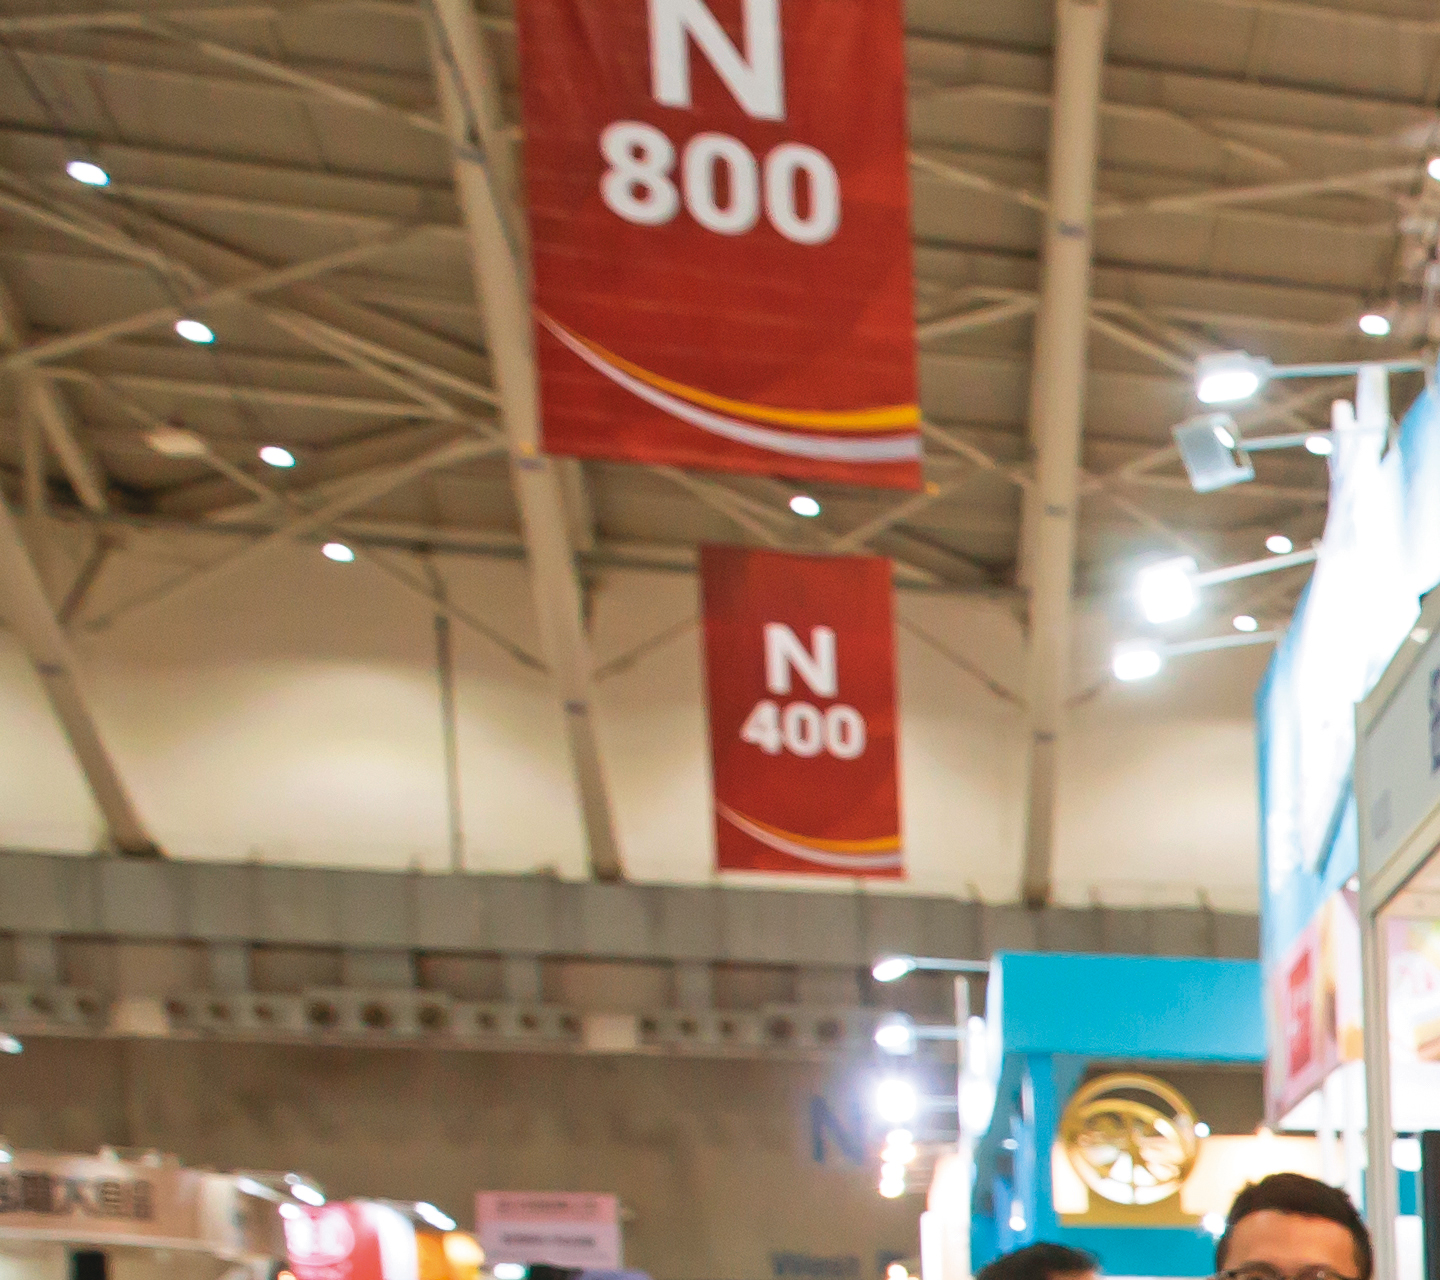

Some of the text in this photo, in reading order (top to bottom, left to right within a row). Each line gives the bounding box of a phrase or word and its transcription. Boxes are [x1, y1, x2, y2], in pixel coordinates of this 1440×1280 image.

[648, 0, 786, 120] N
[599, 121, 841, 244] 800
[763, 621, 838, 697] N
[740, 701, 866, 760] 400
